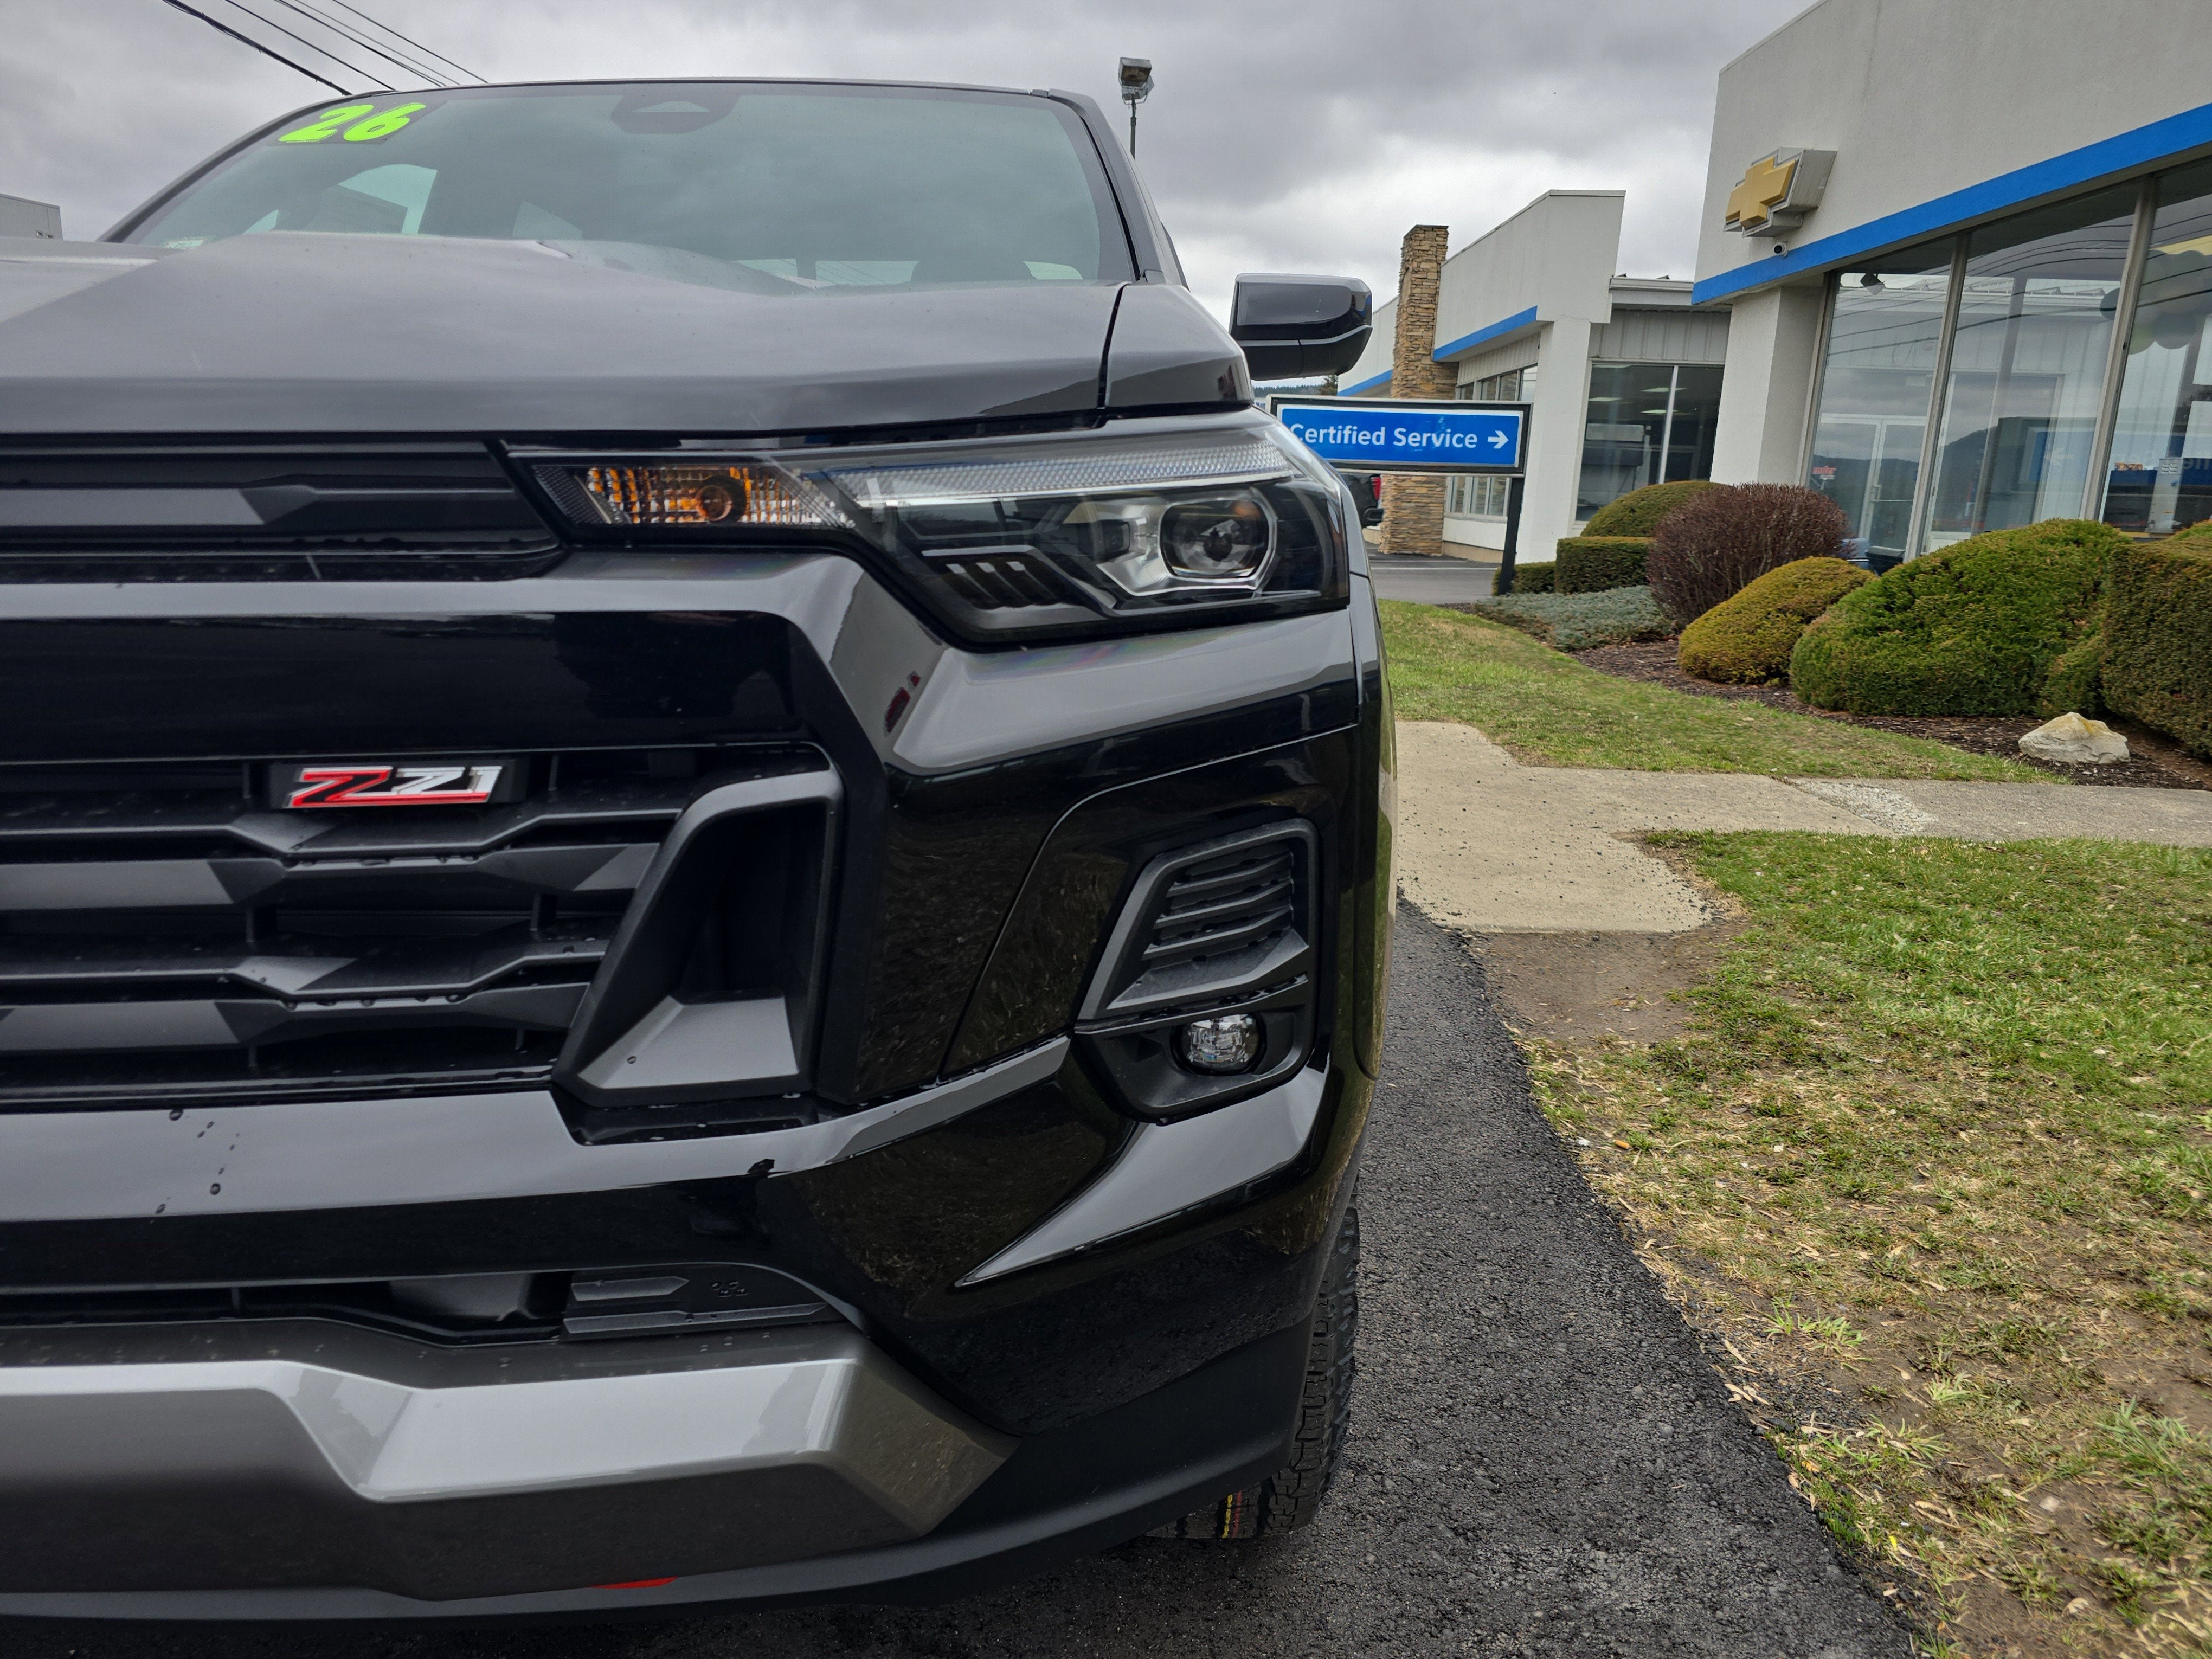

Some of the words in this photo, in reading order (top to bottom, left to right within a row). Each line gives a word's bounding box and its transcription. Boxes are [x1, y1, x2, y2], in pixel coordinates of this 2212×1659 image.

[279, 102, 427, 143] 26
[1290, 423, 1386, 446] Certified
[1392, 427, 1478, 449] Service
[282, 765, 503, 808] Z71
